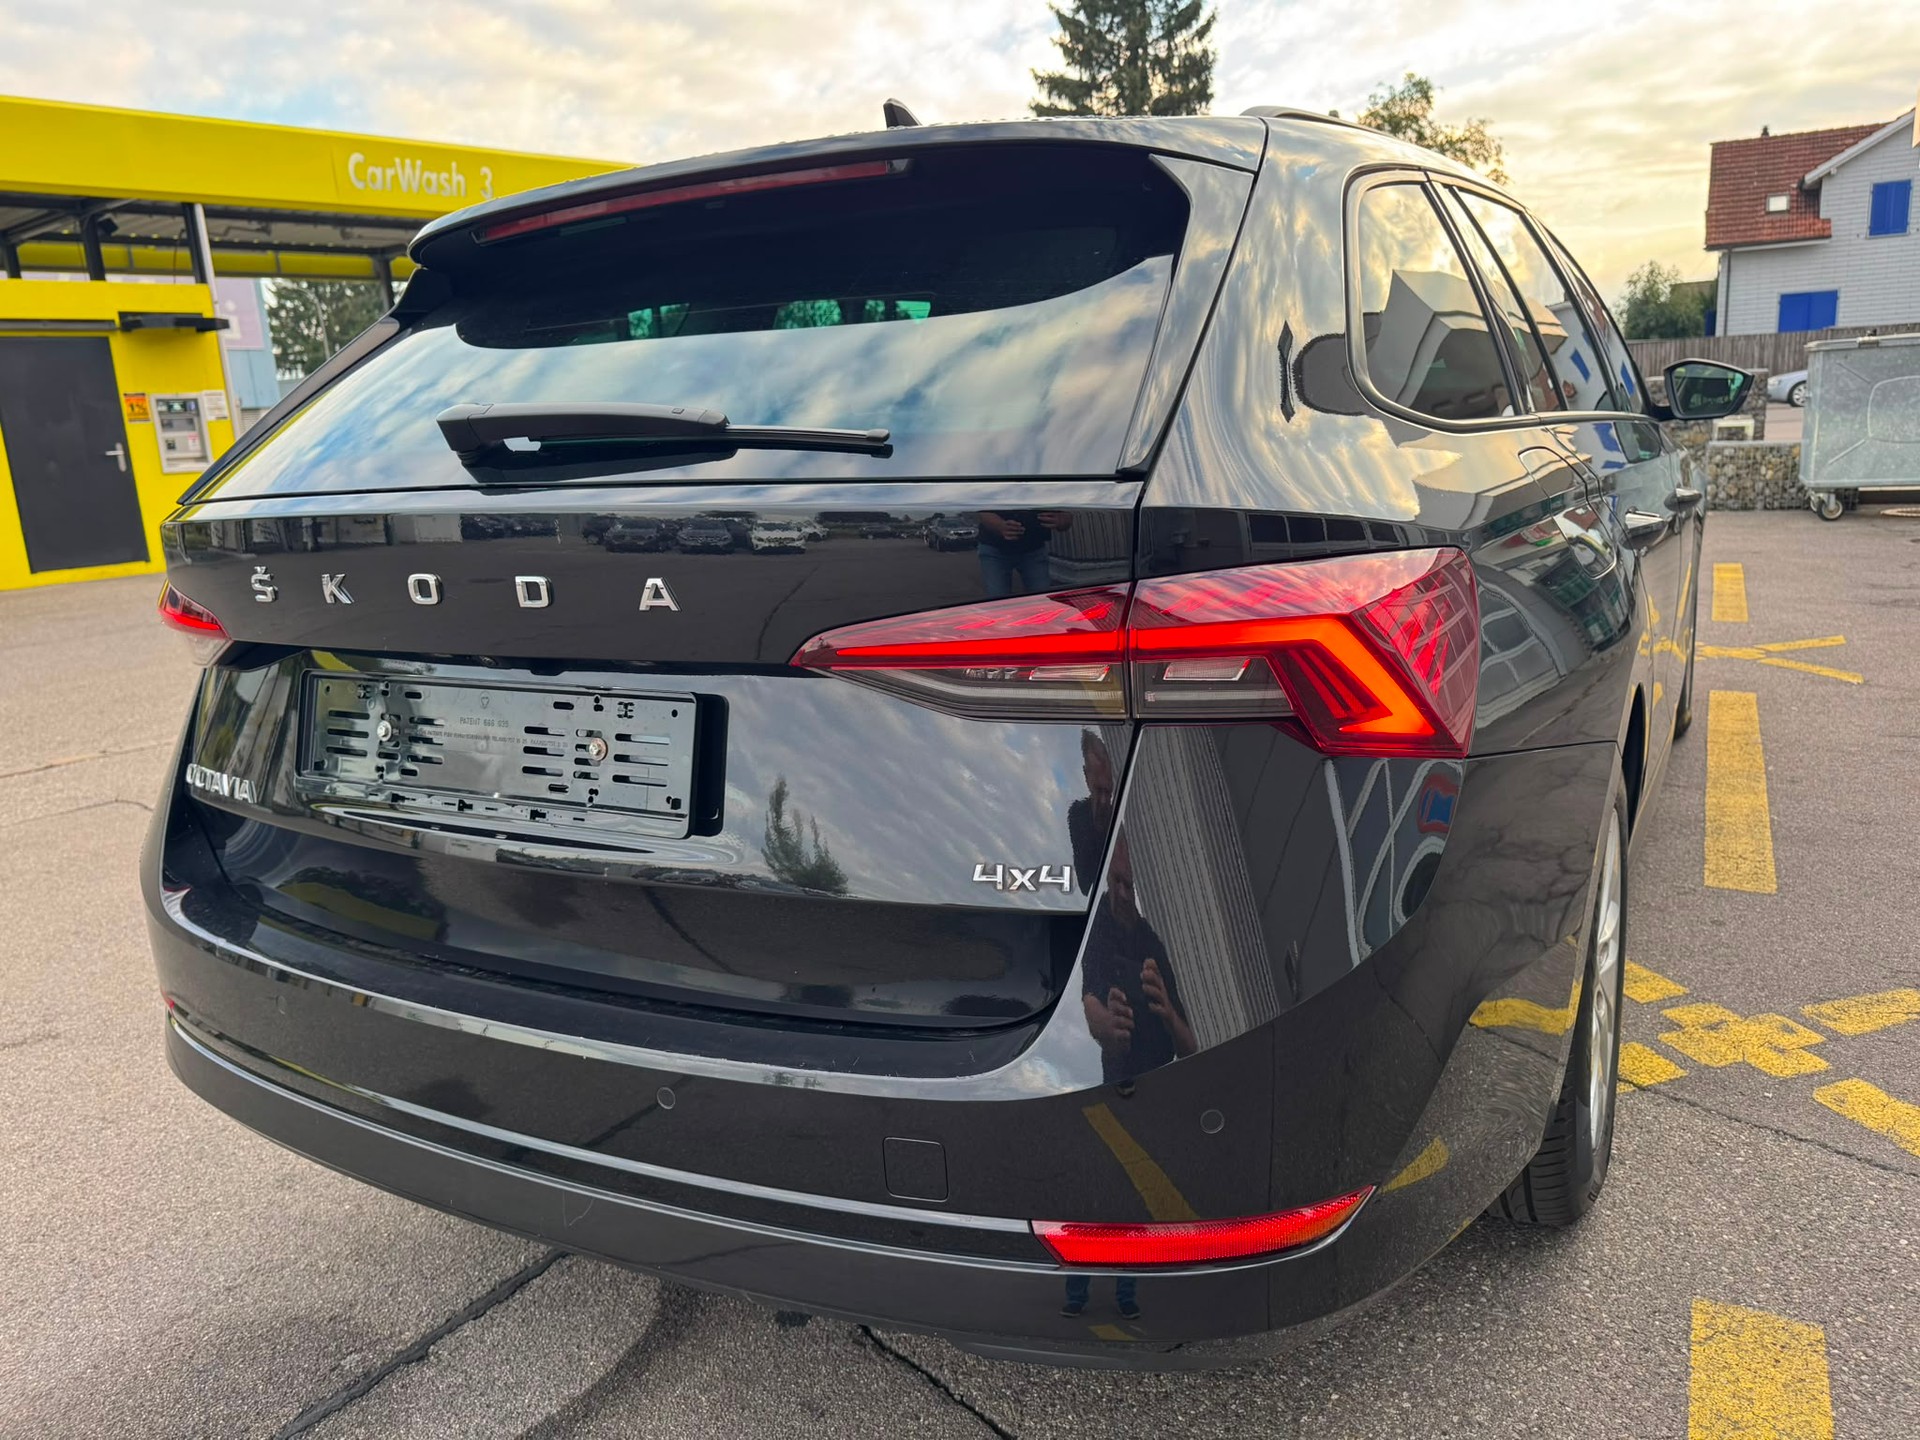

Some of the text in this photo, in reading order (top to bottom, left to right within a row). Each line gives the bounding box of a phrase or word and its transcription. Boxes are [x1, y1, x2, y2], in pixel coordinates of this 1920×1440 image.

[348, 152, 494, 200] CarWash 3
[249, 565, 682, 612] ŠKODA
[973, 864, 1071, 892] 4x4
